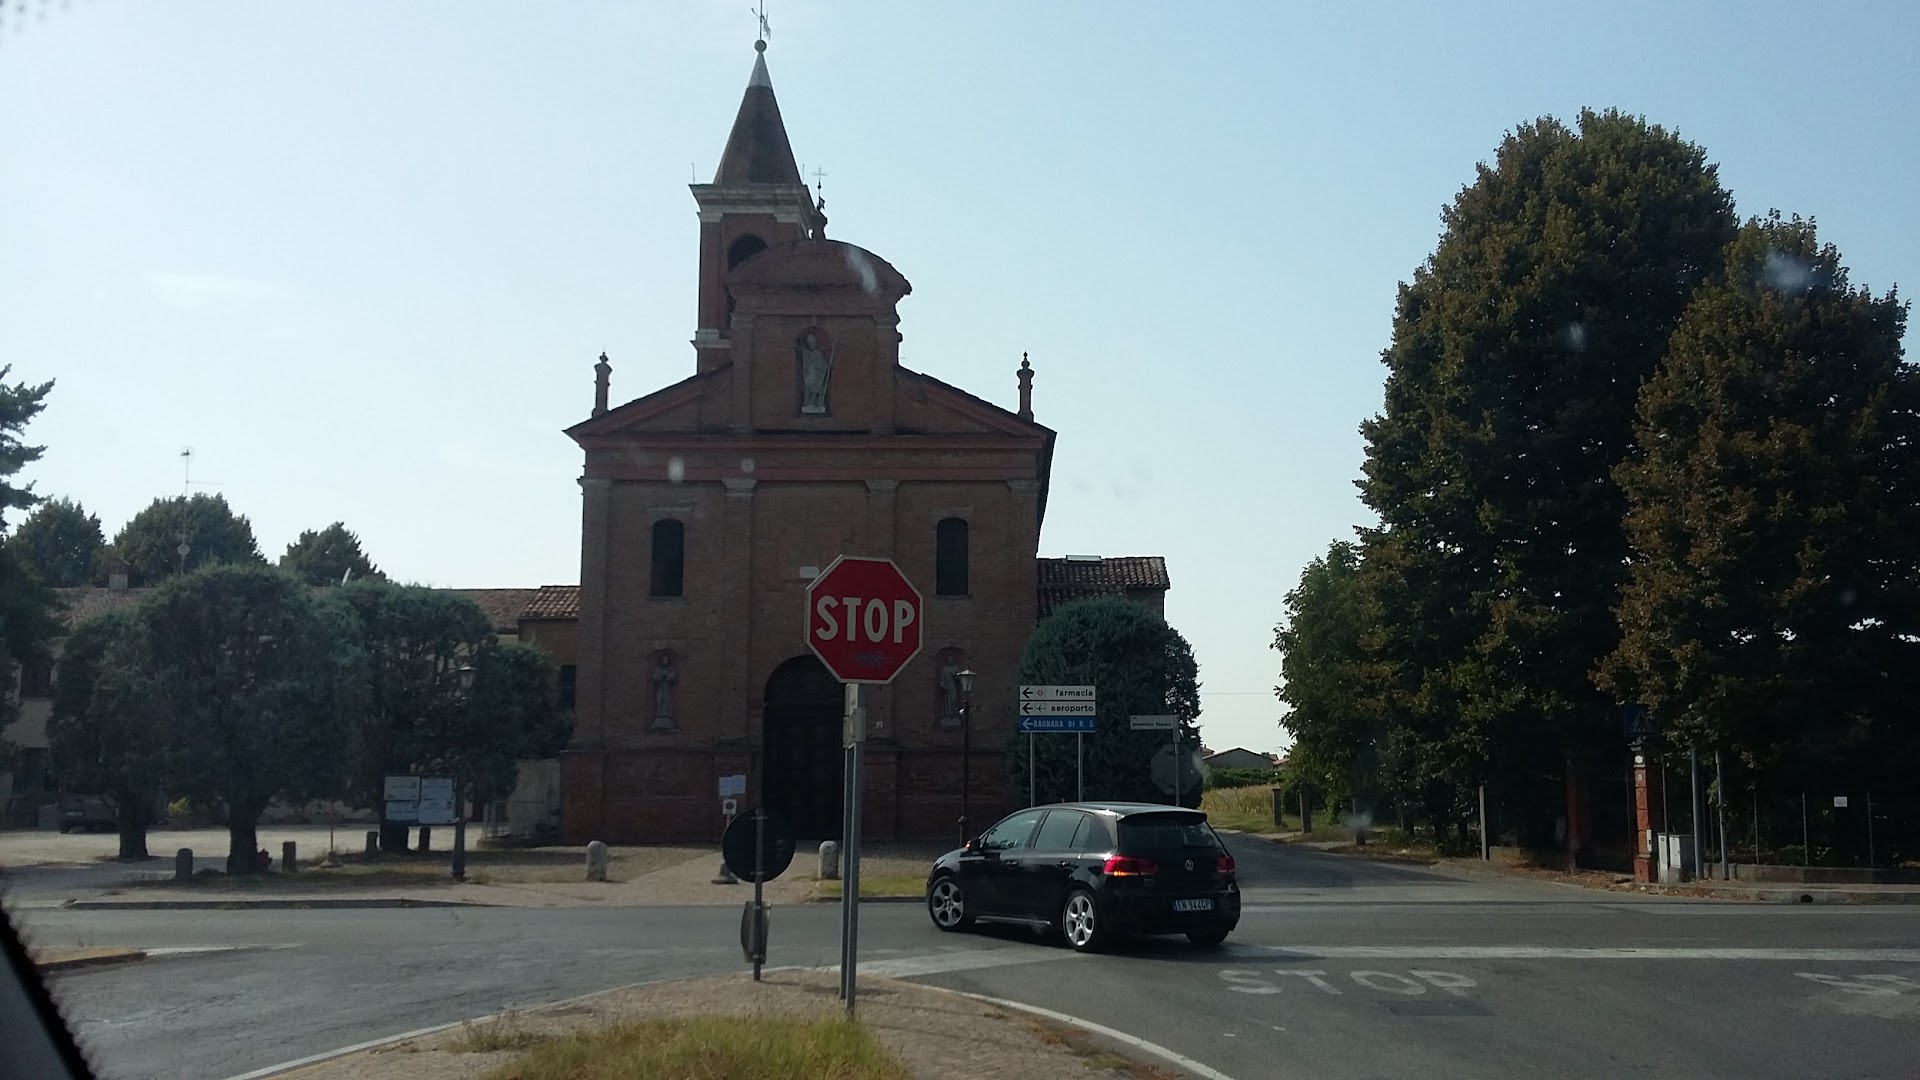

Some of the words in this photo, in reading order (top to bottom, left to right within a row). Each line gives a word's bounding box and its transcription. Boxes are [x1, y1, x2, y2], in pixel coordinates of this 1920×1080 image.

[815, 595, 916, 644] STOP
[1055, 689, 1093, 697] farmacia
[1051, 705, 1094, 713] aeroporto
[1033, 720, 1064, 728] BAGNARA
[1068, 720, 1075, 728] DI
[1217, 969, 1478, 996] STOP
